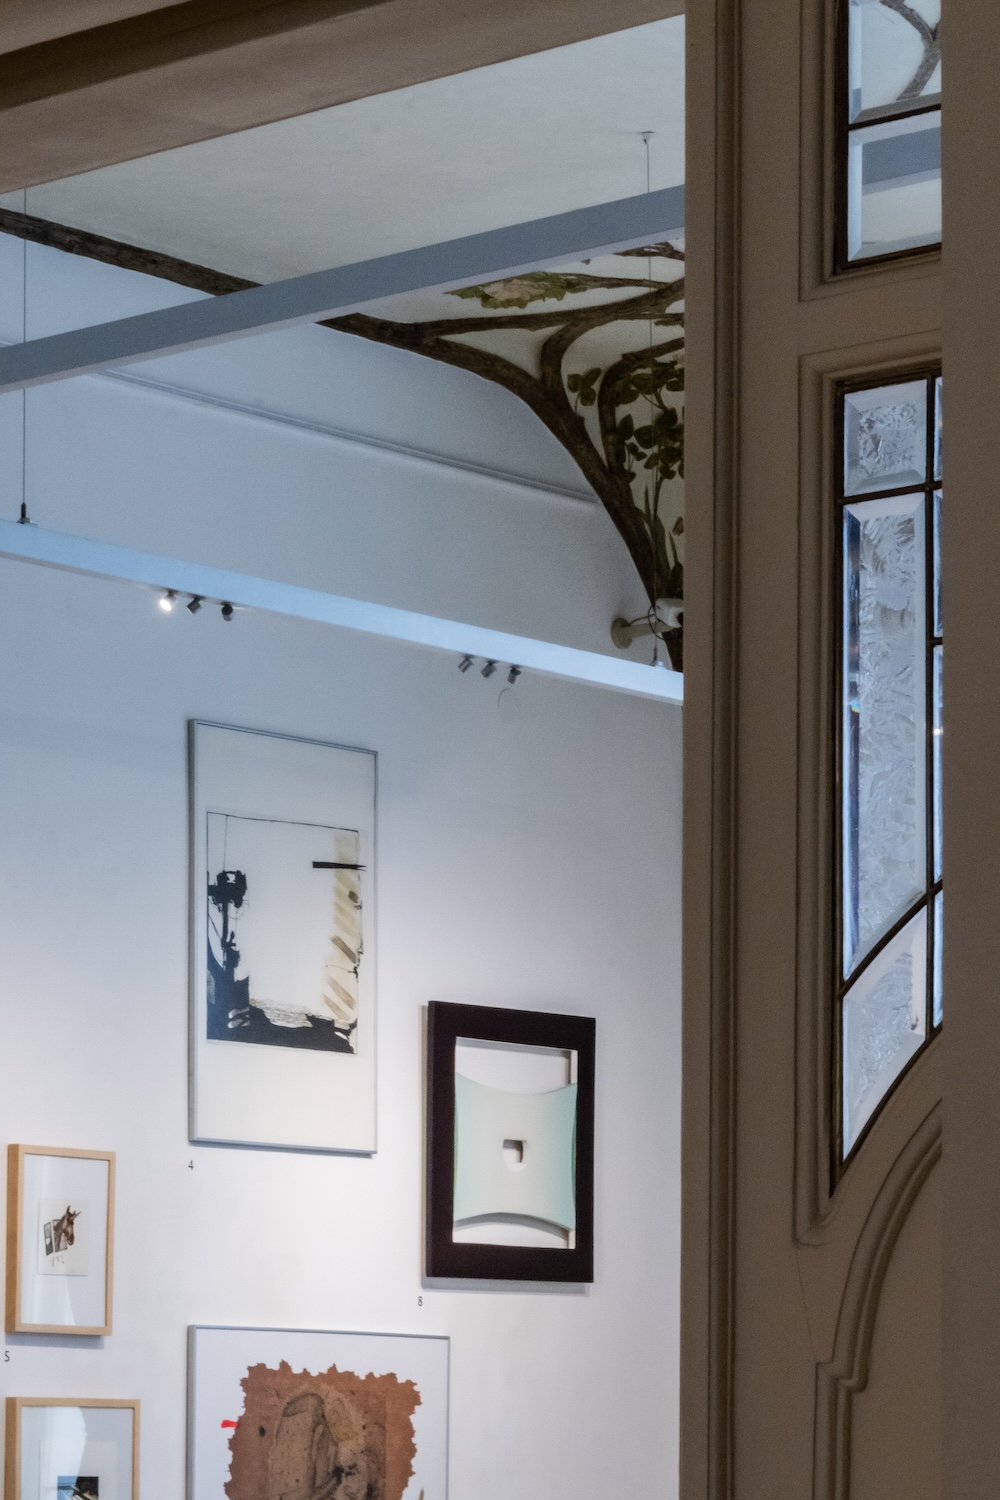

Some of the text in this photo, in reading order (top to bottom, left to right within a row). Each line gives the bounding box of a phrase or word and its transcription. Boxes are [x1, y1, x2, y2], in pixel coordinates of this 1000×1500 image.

[188, 1160, 194, 1171] 4
[417, 1296, 423, 1306] 8
[4, 1350, 10, 1362] 5
